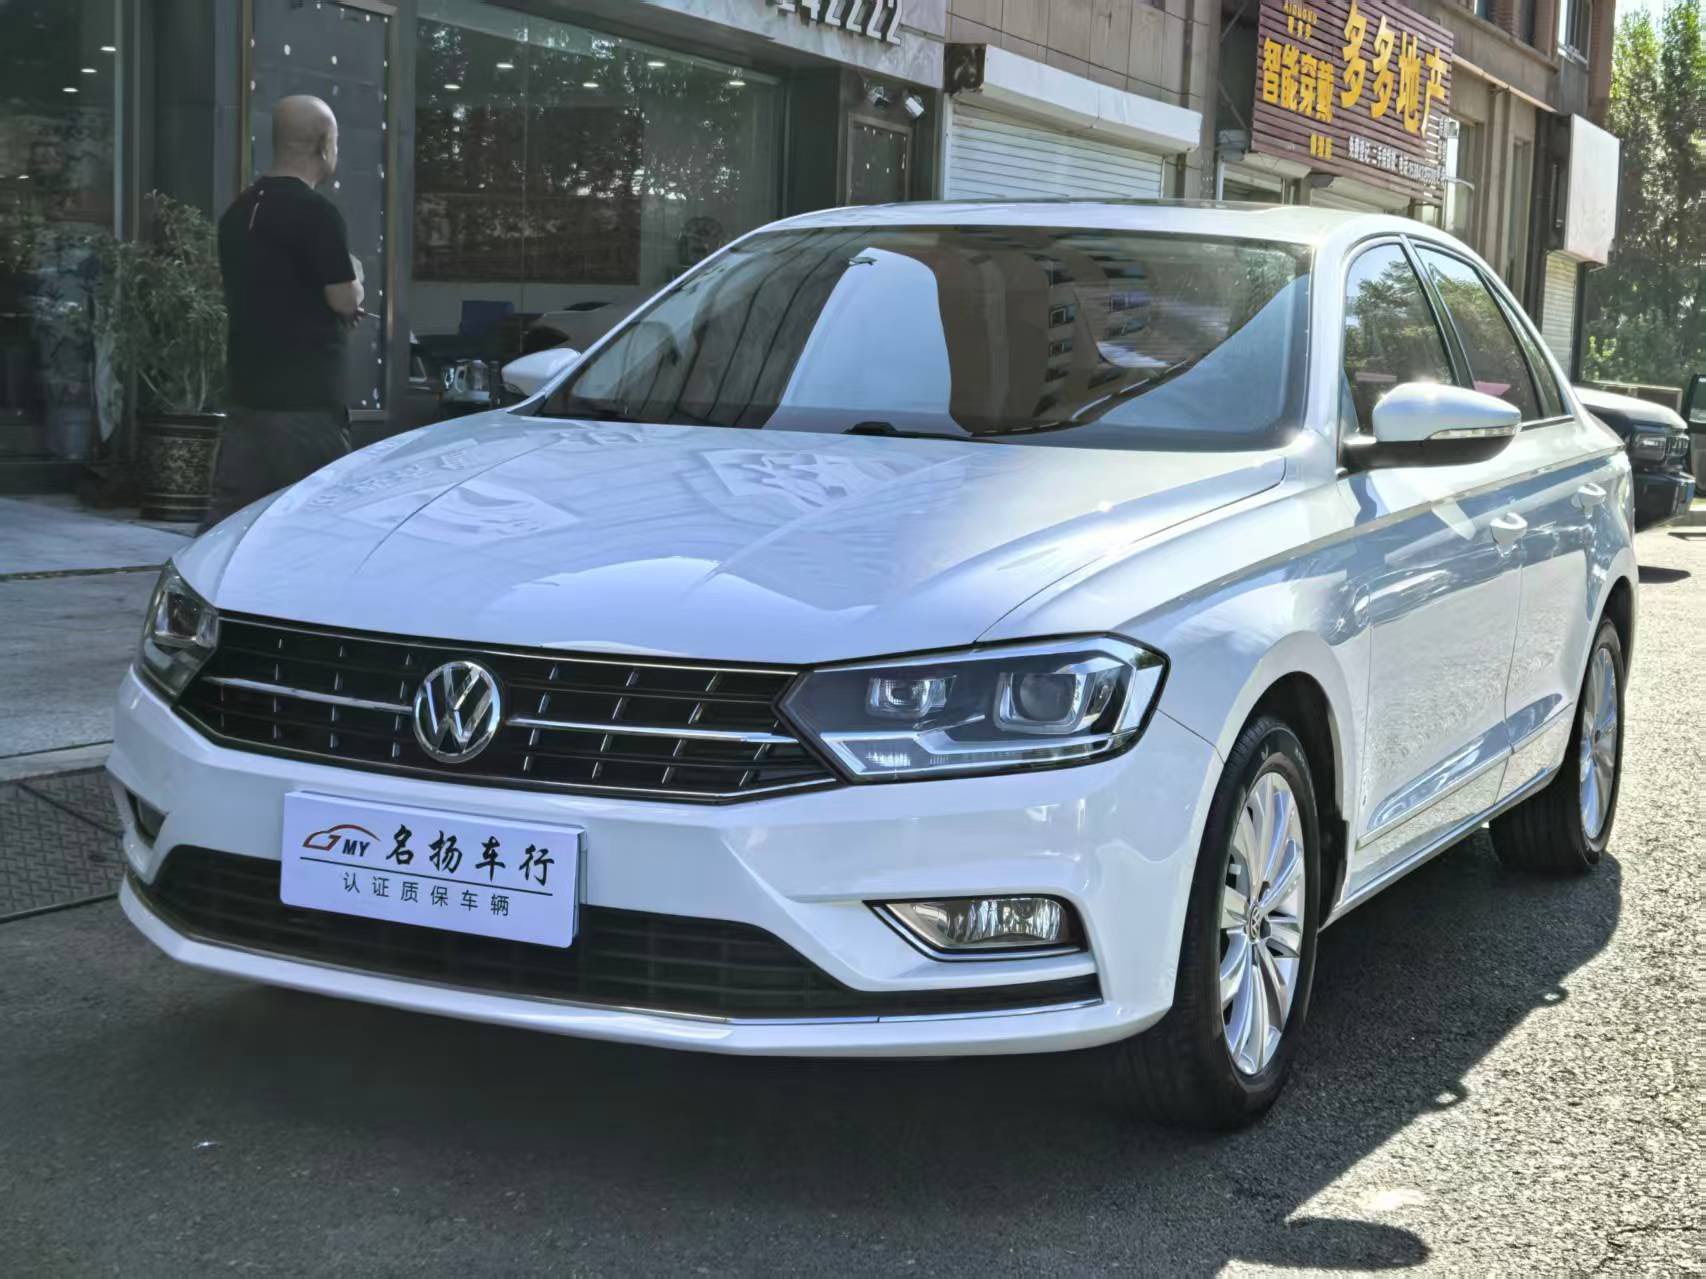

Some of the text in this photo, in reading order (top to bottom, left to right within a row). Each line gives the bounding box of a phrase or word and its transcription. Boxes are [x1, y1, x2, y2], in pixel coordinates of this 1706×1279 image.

[1340, 0, 1448, 137] 多多地产
[342, 838, 371, 857] MY
[385, 824, 555, 887] 名扬车行
[342, 872, 510, 917] 认证质保车辆
